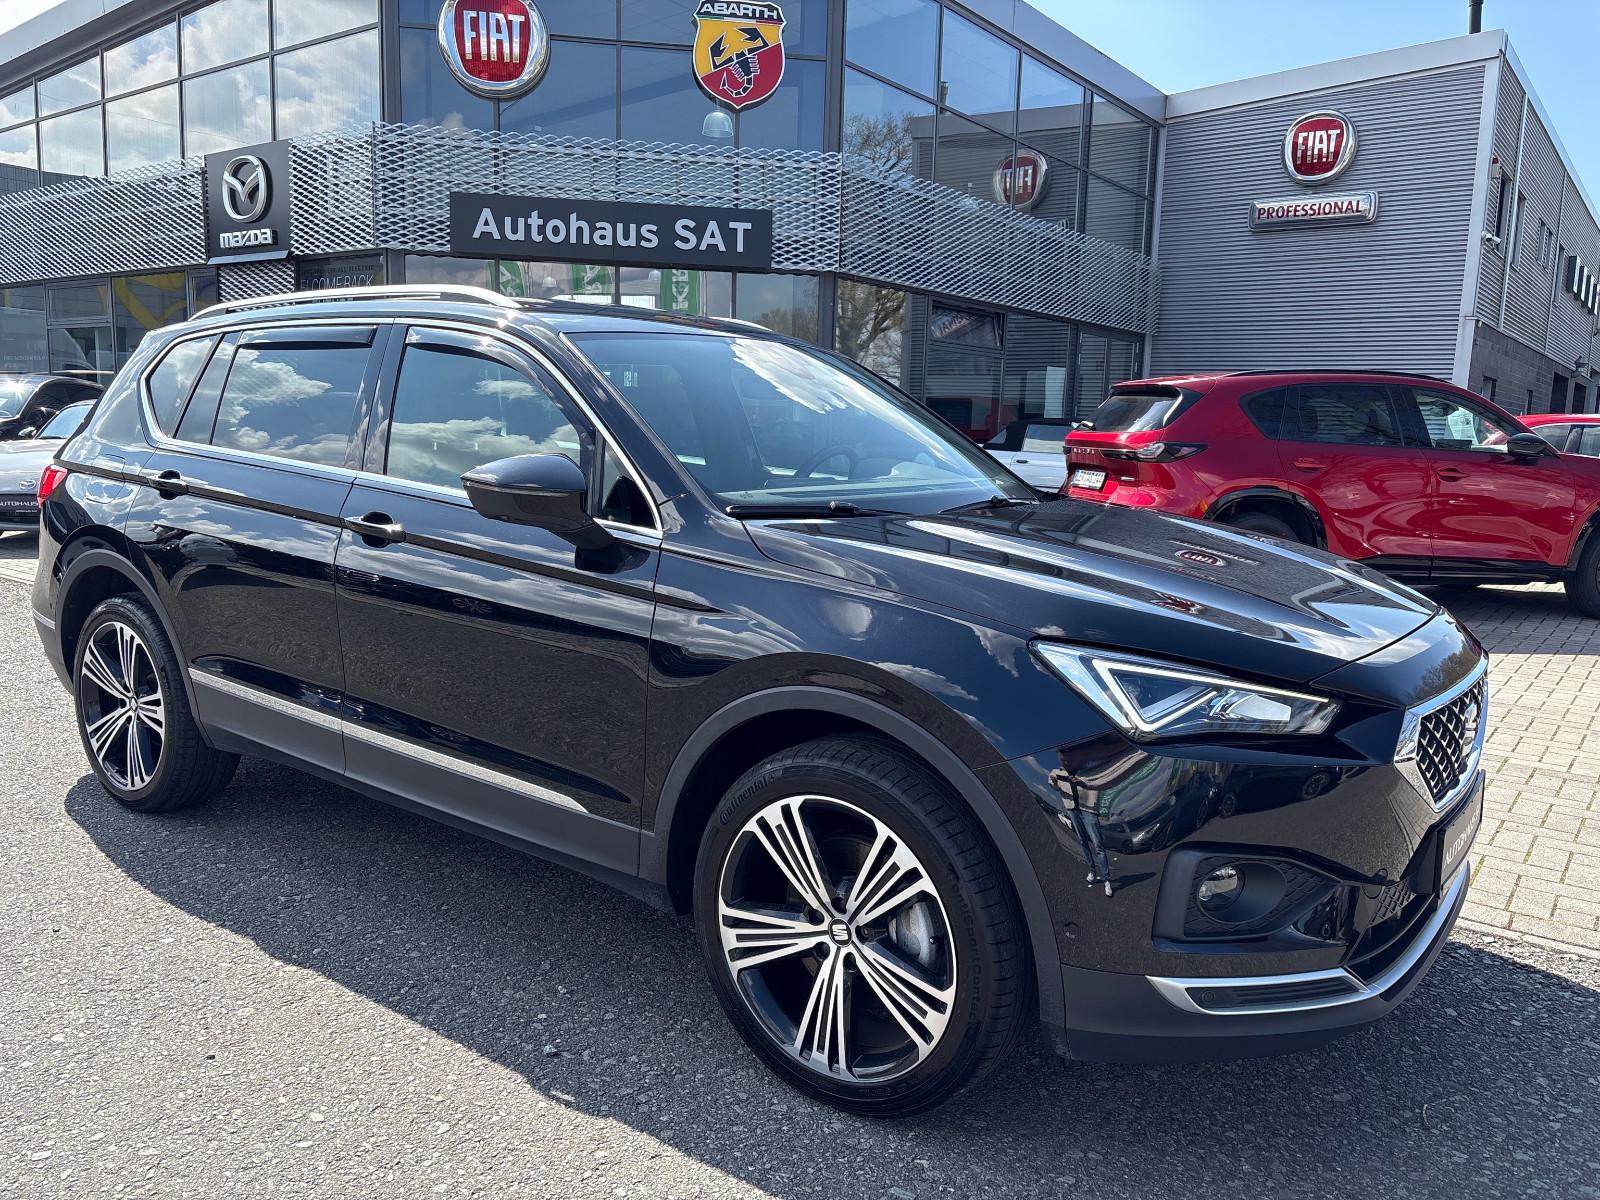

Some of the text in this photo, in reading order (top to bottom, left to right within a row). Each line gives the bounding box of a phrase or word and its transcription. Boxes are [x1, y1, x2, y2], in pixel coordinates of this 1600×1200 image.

[700, 2, 778, 19] ABARTH
[463, 10, 525, 63] FIAT
[1297, 128, 1340, 164] FIAT
[472, 207, 752, 253] Autohaus SAT
[1257, 200, 1362, 220] PROFESSIONAL
[719, 776, 769, 825] Continental
